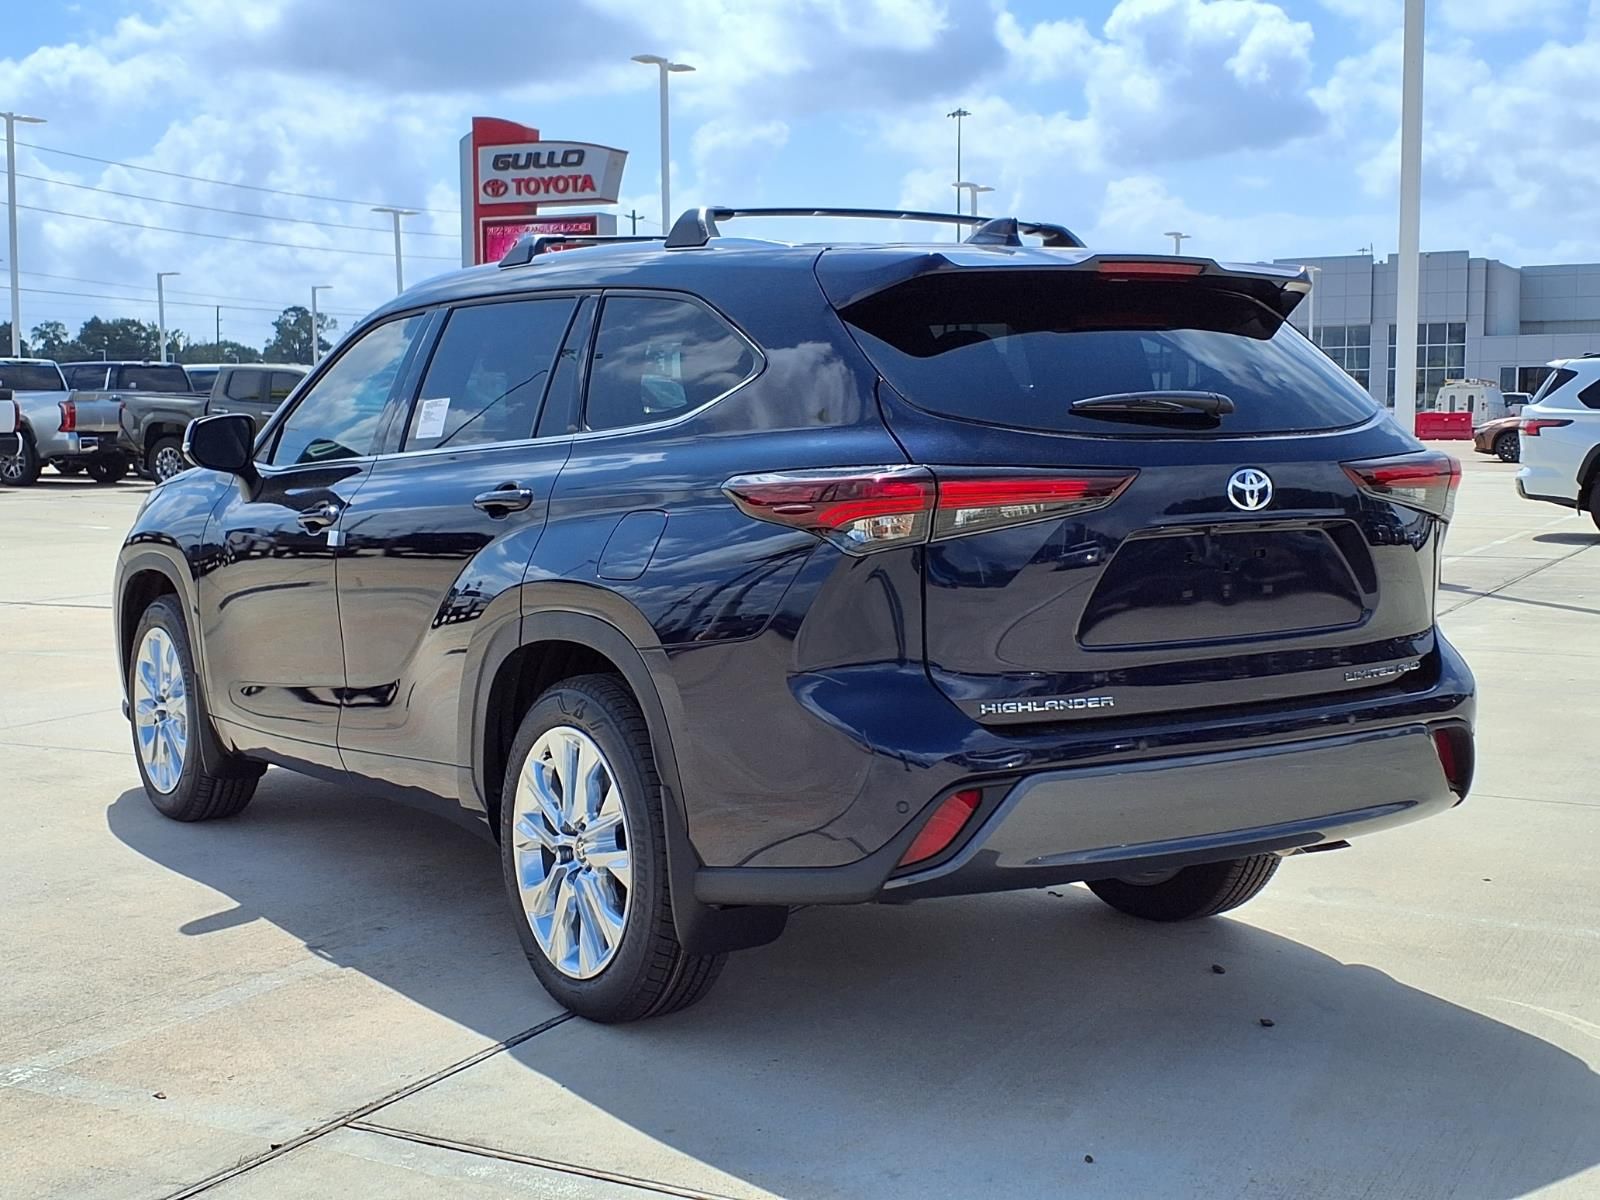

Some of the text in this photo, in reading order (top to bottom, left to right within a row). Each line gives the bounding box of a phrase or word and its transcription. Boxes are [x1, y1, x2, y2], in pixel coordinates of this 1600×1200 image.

[492, 149, 586, 171] GULLO
[511, 174, 596, 196] TOYOTA
[980, 696, 1115, 715] HIGHLANDER
